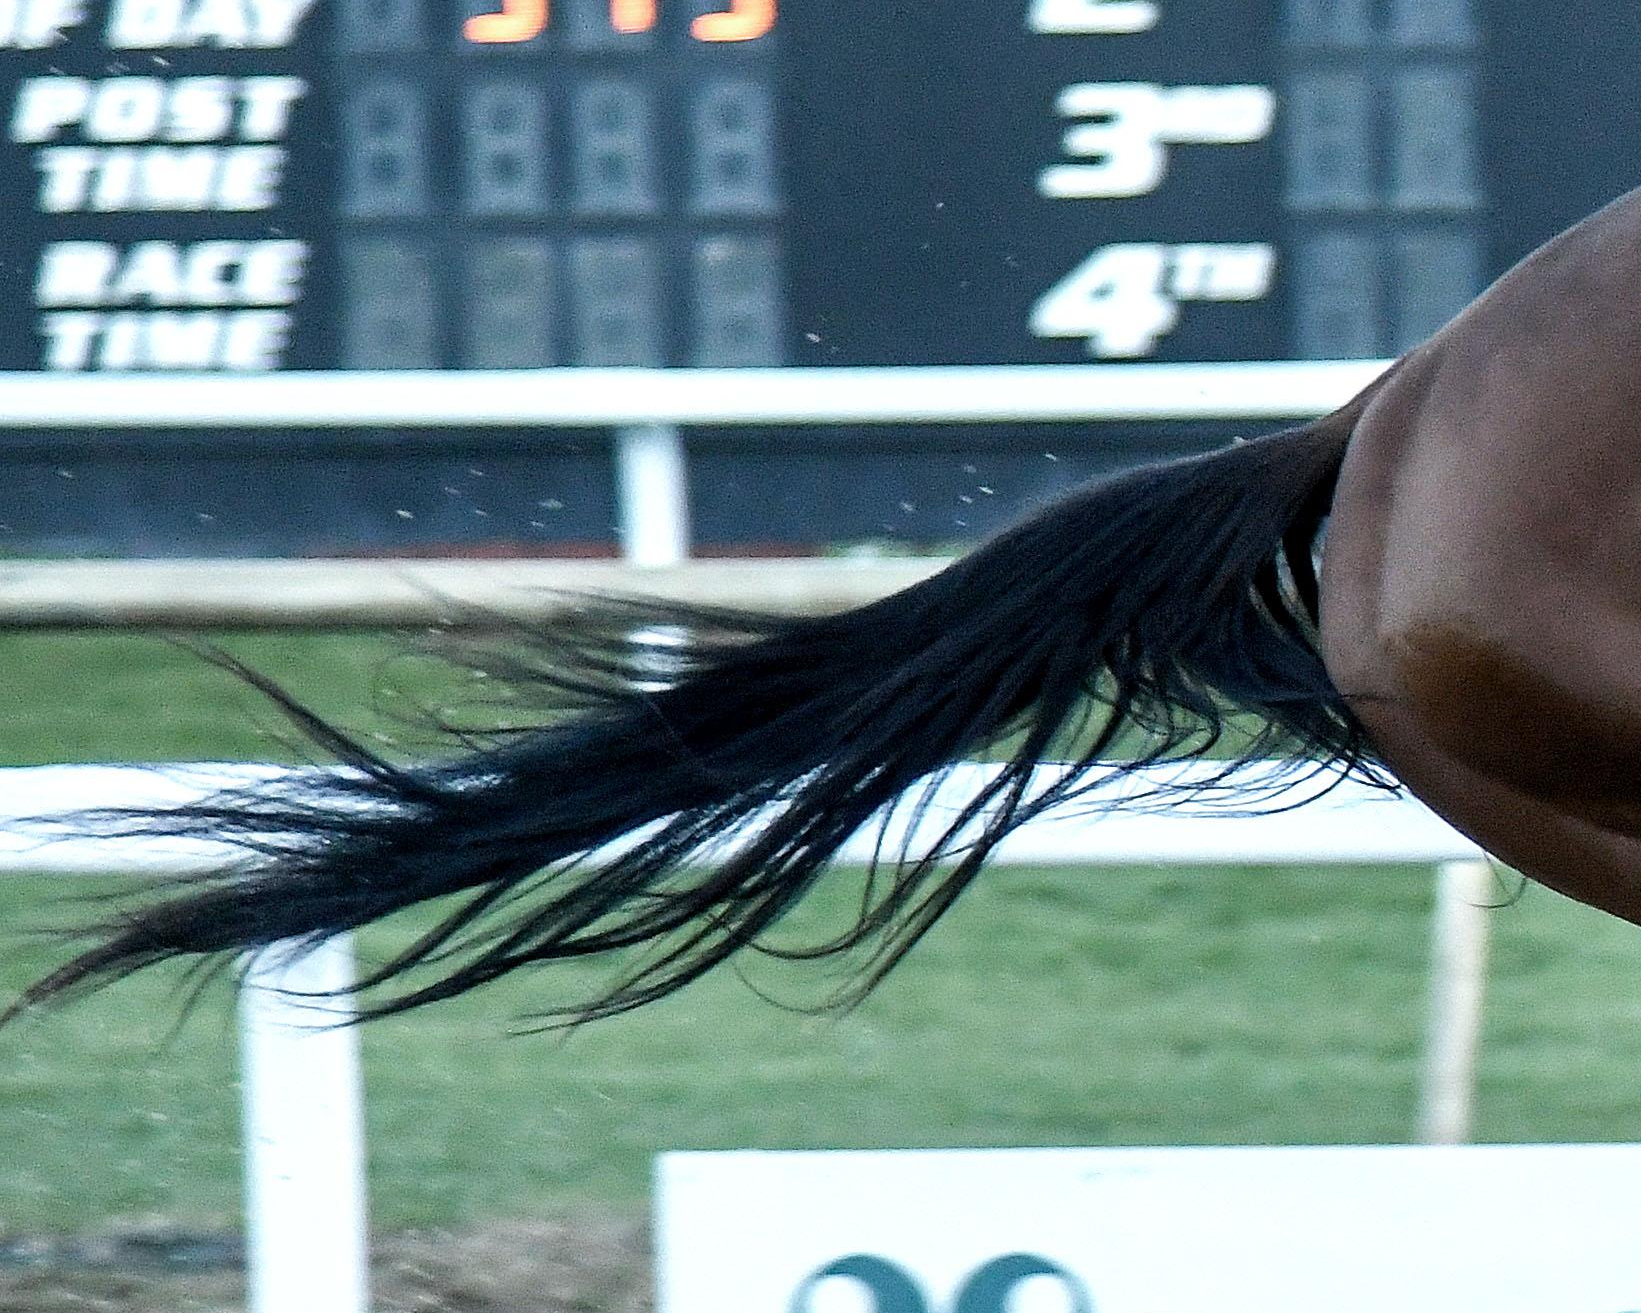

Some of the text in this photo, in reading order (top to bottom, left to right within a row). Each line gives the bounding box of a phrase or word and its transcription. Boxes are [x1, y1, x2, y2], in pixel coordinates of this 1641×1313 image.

[11, 74, 306, 144] POST
[38, 144, 288, 214] TIME
[36, 238, 309, 307] RACE
[44, 309, 293, 370] TIME
